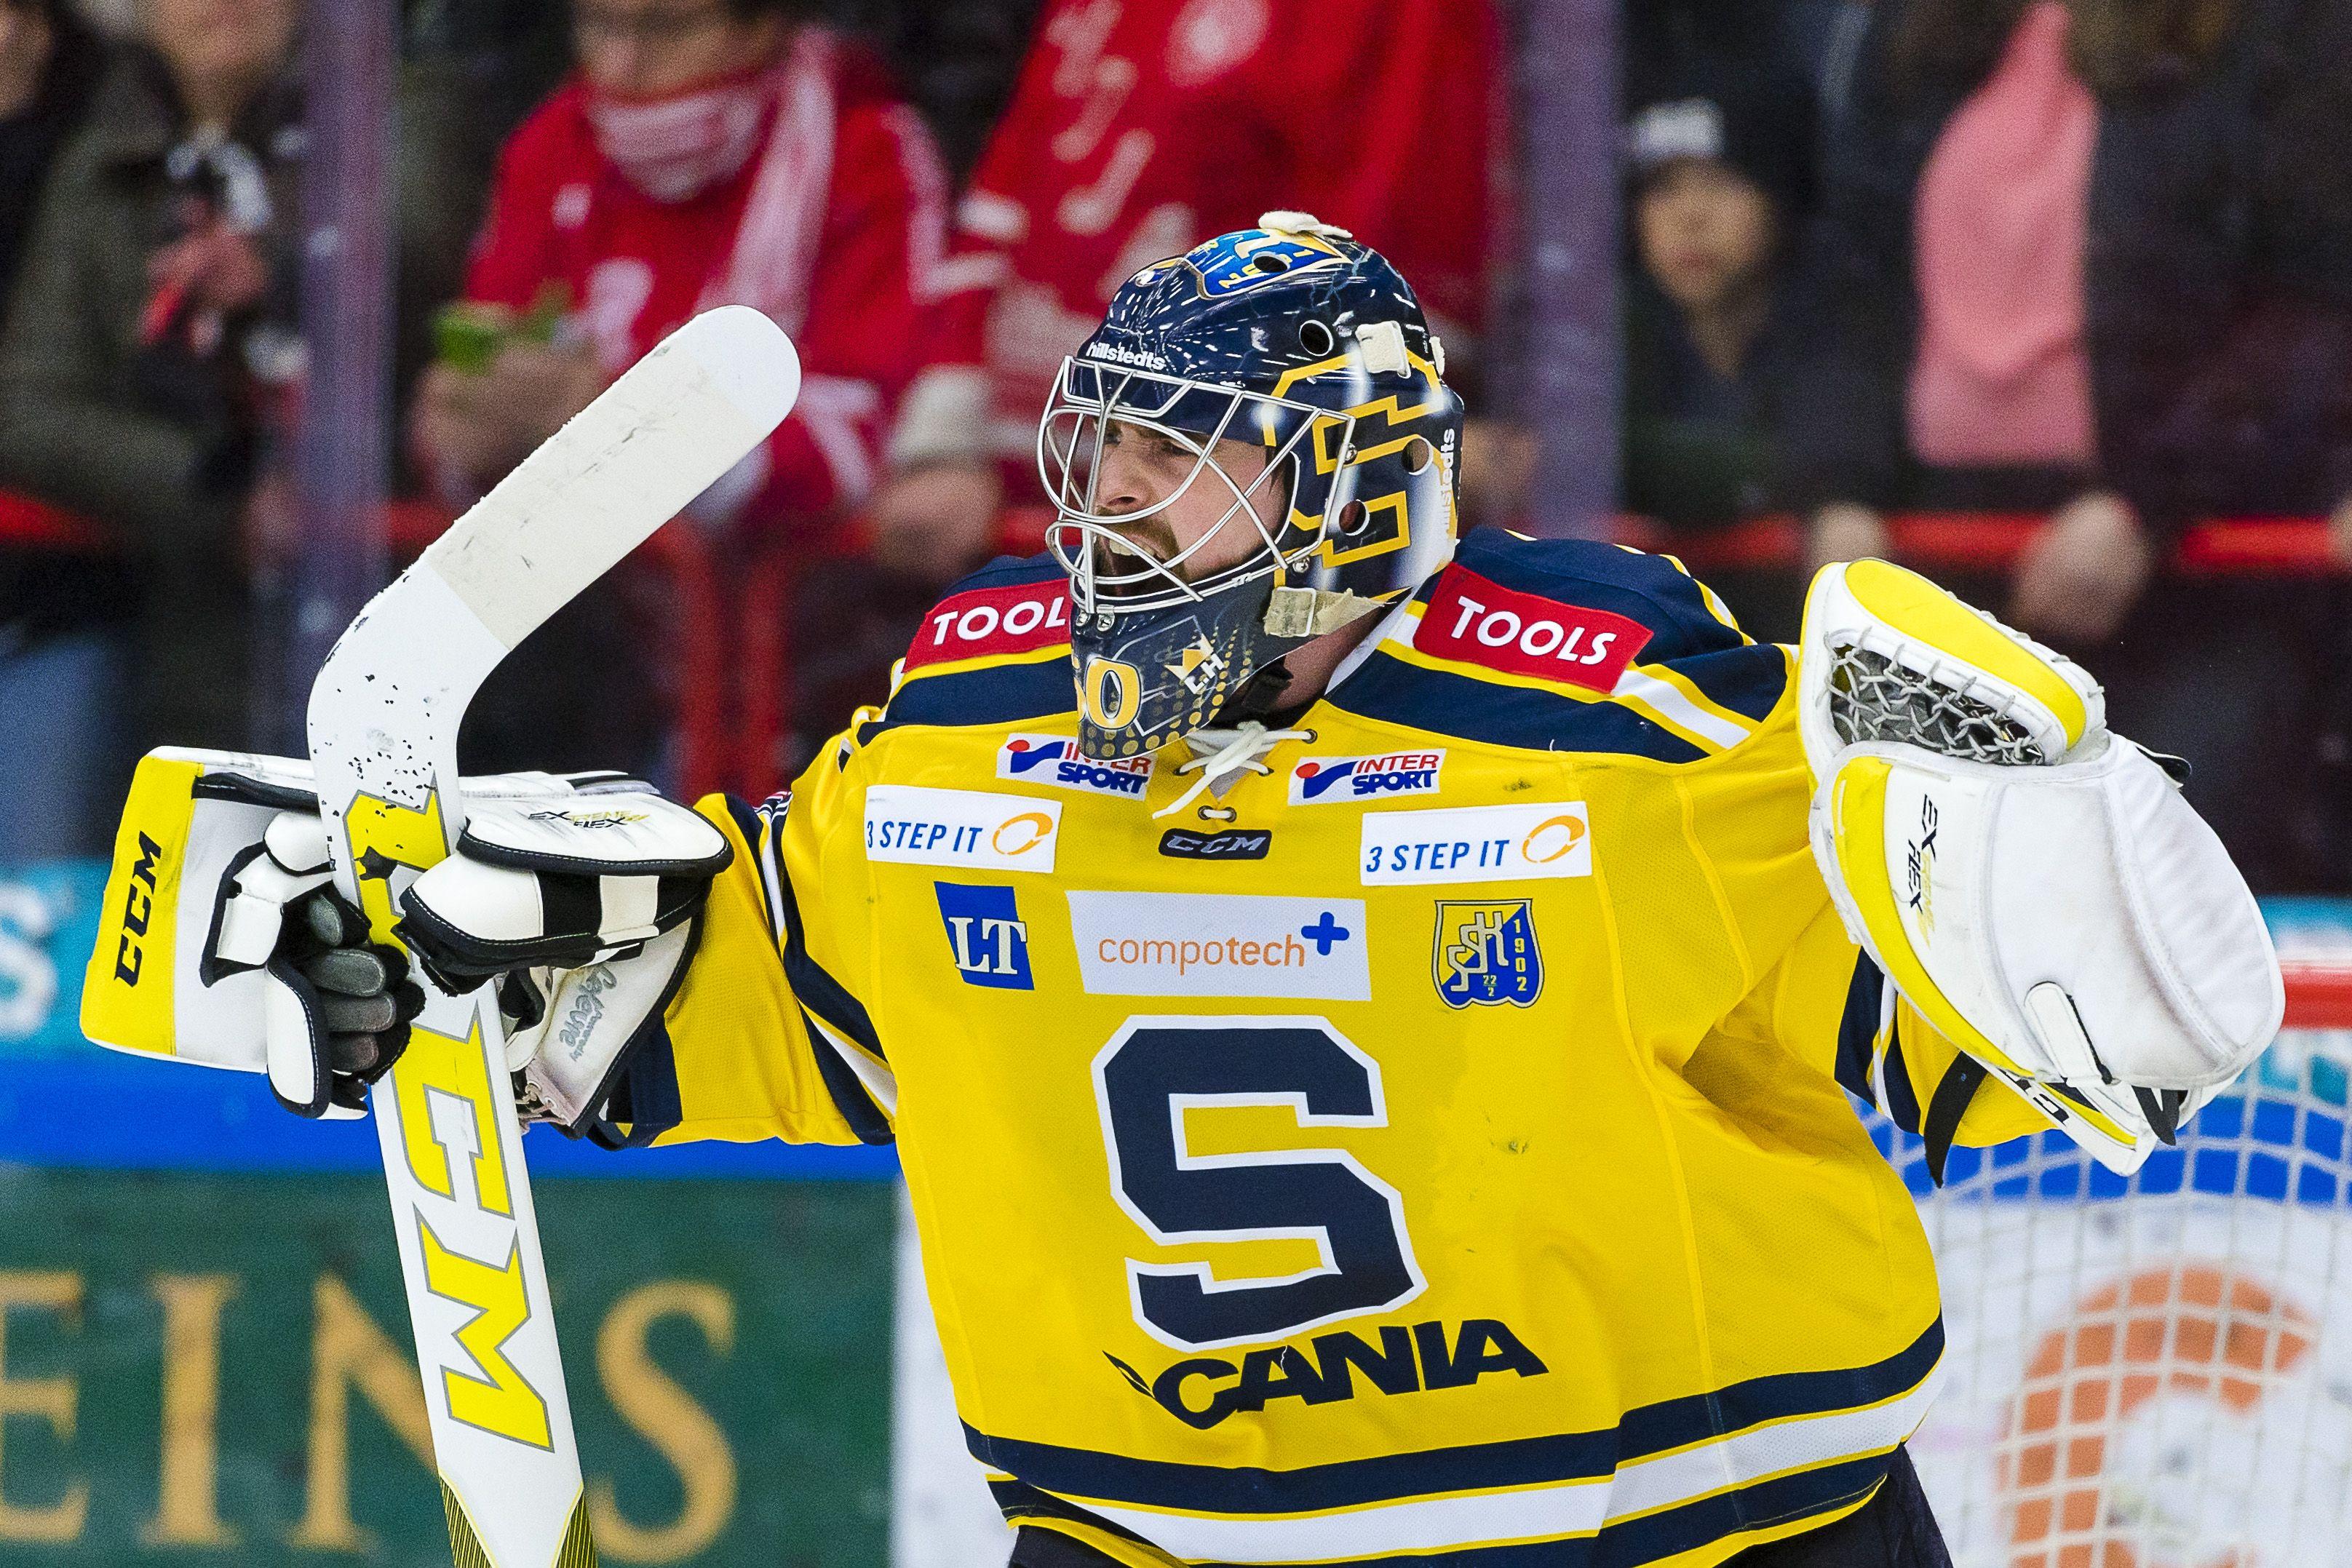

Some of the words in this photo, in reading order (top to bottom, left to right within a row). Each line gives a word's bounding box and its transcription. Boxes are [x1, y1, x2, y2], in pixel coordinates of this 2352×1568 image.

[1085, 341, 1167, 371] hillstedts
[934, 597, 1066, 645] TOOL
[1450, 595, 1617, 665] TOOLS
[1065, 741, 1151, 775] IER
[1356, 754, 1439, 773] INTER
[1057, 761, 1149, 795] SPORT
[1351, 768, 1437, 795] SPORT
[573, 816, 628, 829] FLEX
[867, 820, 874, 848] 3
[879, 820, 947, 851] STEP
[953, 826, 984, 853] IT
[1166, 835, 1267, 854] CCM
[1366, 846, 1383, 873] 3
[1391, 842, 1471, 872] STEP
[1479, 840, 1510, 867] IT
[1908, 839, 1923, 915] FLEX
[114, 829, 162, 988] CCM
[947, 916, 1028, 975] LT
[1097, 934, 1306, 976] compotech
[1513, 918, 1527, 992] 1902
[1090, 1014, 1429, 1354] S
